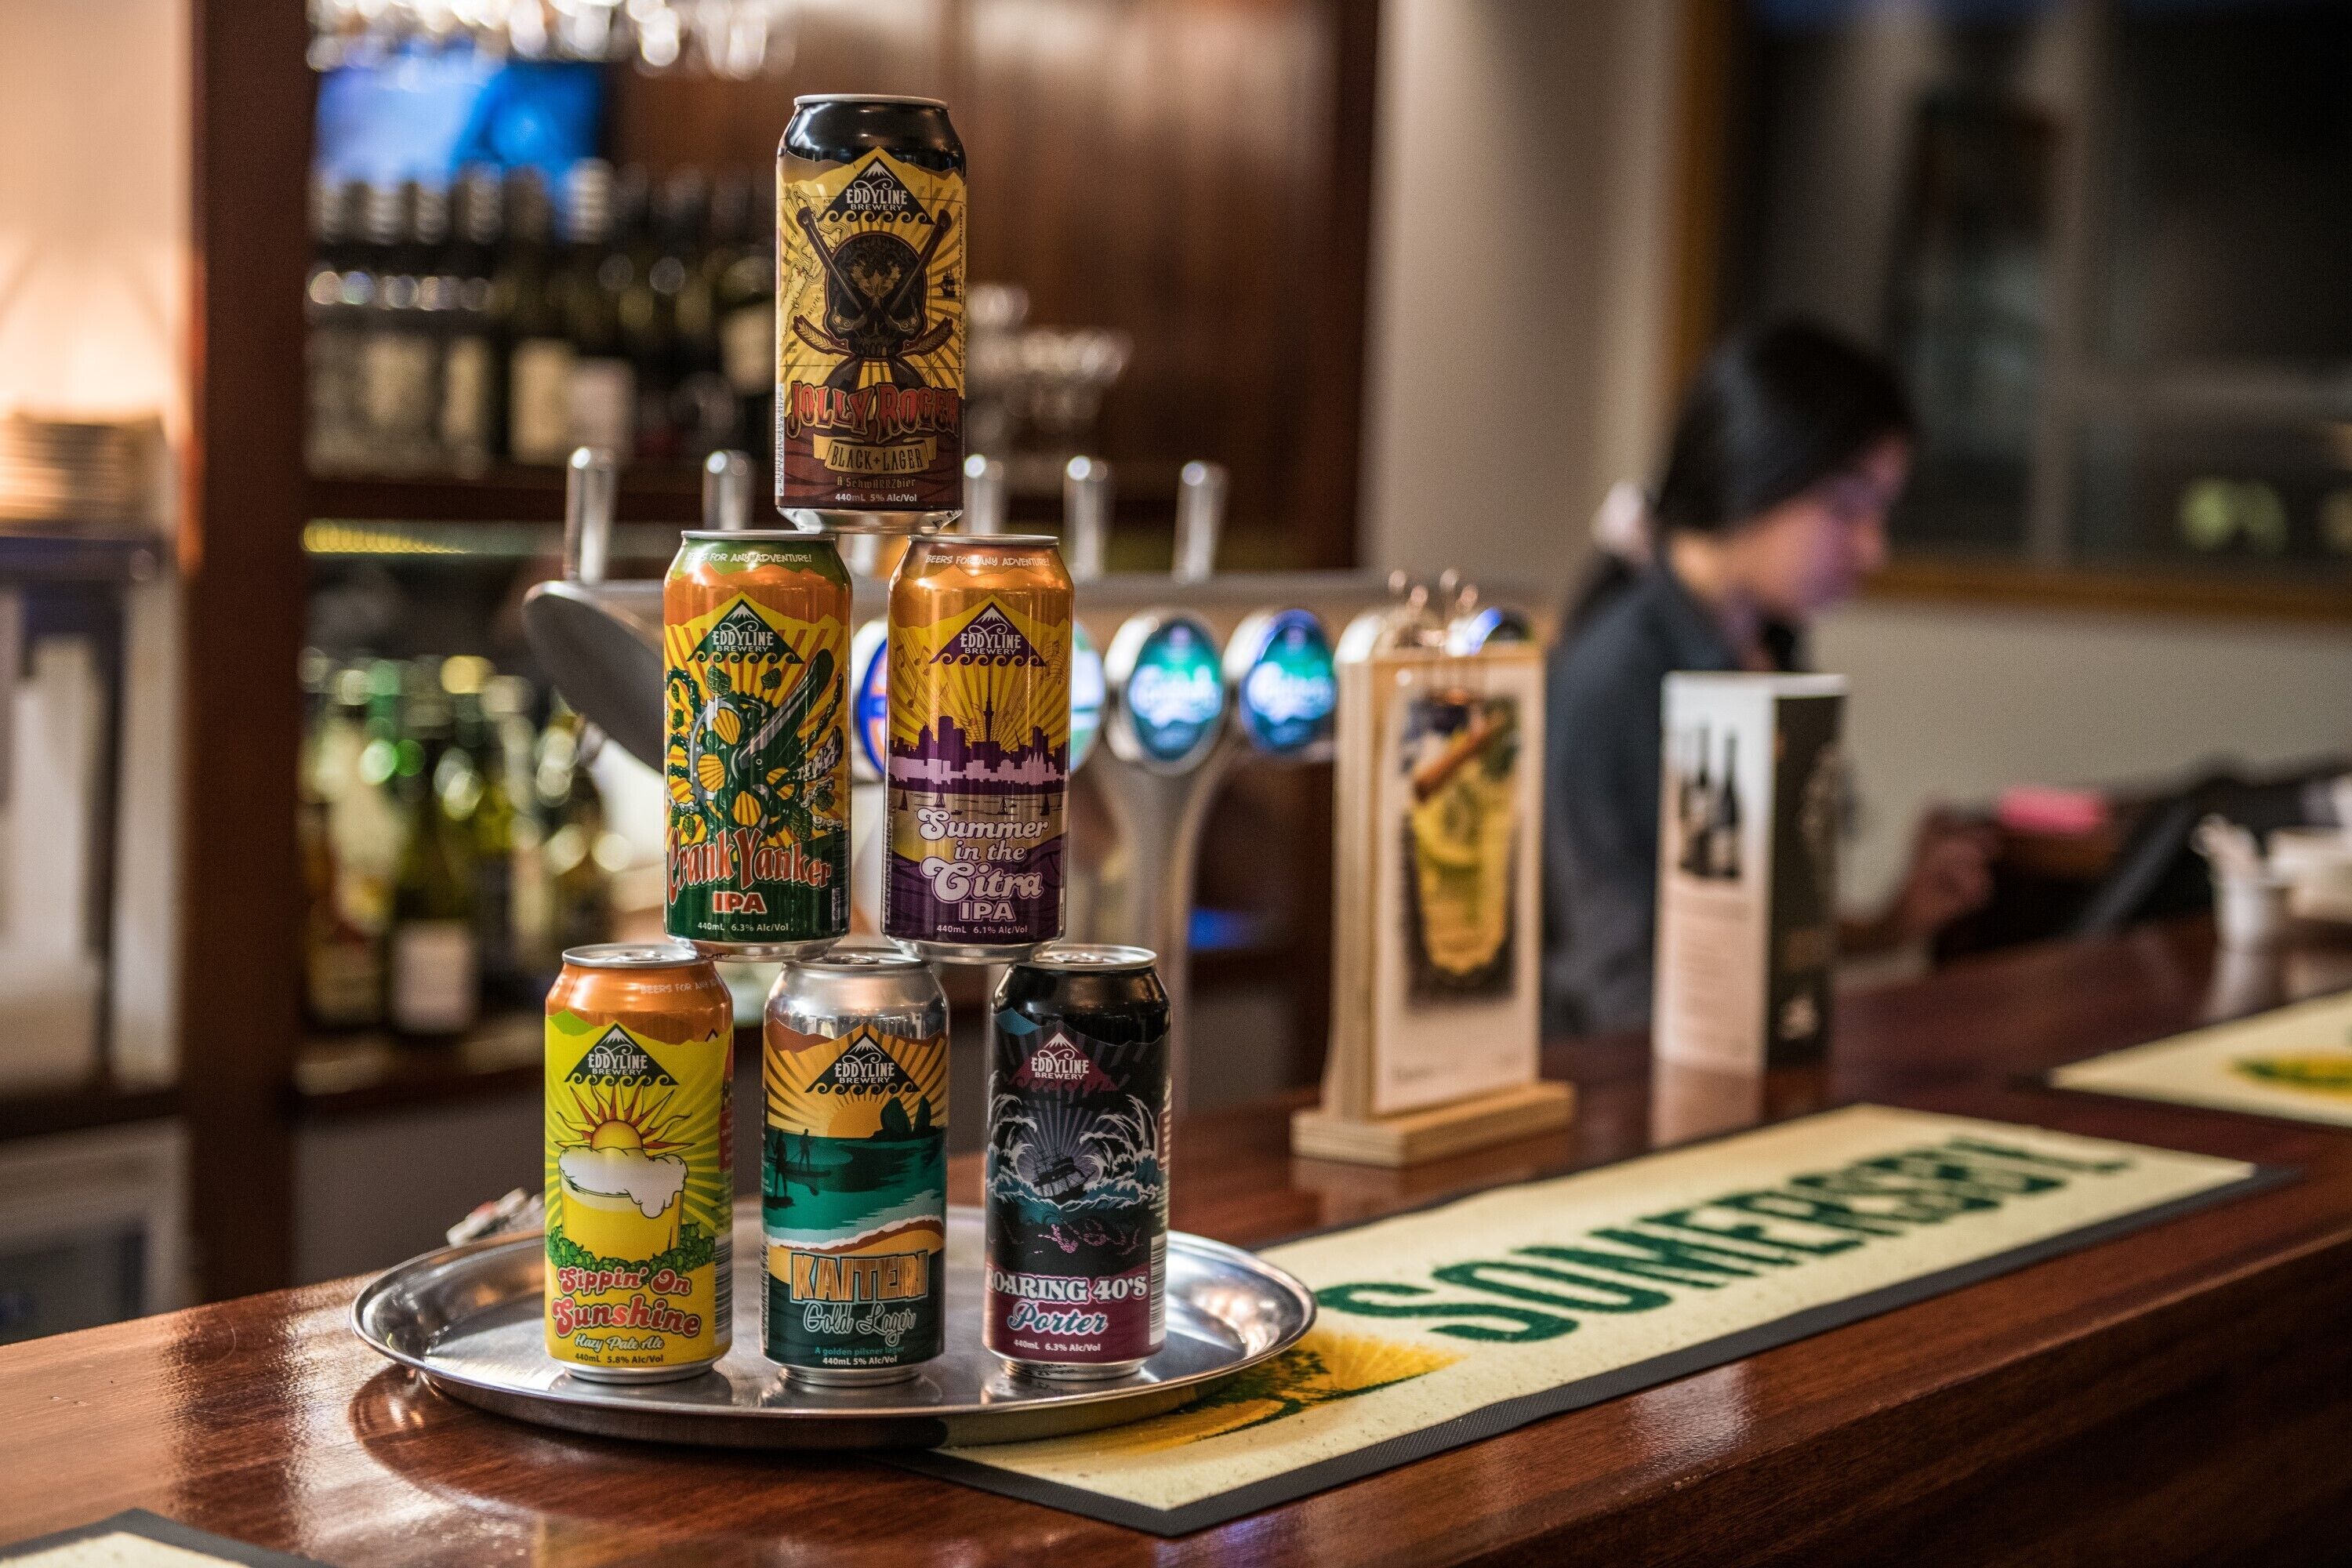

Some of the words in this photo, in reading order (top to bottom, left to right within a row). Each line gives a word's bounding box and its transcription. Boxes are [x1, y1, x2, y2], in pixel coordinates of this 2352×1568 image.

[846, 178, 907, 205] EDDYLINE
[786, 381, 874, 439] JOLLY
[831, 445, 871, 469] BLACK
[883, 446, 924, 470] LAGER
[835, 493, 866, 502] 440mL
[710, 553, 728, 561] FOR
[730, 554, 749, 562] ANY
[753, 554, 812, 563] ADVENTURE!
[925, 555, 953, 564] BEERS
[979, 557, 998, 566] ANY
[1002, 557, 1050, 567] ADVENTURE!
[712, 620, 774, 646] EDDYLINE
[960, 625, 1022, 649] EDDYLINE
[916, 808, 1049, 841] Summer
[953, 840, 982, 862] in
[985, 840, 1027, 862] the
[668, 826, 736, 906] Crank
[732, 826, 832, 891] Yanker
[920, 856, 1044, 903] Citra
[713, 891, 768, 914] IPA
[959, 900, 1016, 922] IPA
[697, 922, 725, 931] 440mL
[757, 923, 789, 931] Alc/Vol
[937, 924, 967, 933] 440mL
[973, 925, 996, 934] 6.1%
[998, 924, 1028, 934] Alc/Vol
[640, 984, 673, 994] BEERS
[676, 982, 691, 992] FOR
[588, 1044, 648, 1069] EDDYLINE
[834, 1052, 895, 1077] EDDYLINE
[1031, 1049, 1089, 1074] EDDYLINE
[1035, 1072, 1084, 1080] BREWERY
[557, 1267, 648, 1296] Sippin'
[651, 1269, 692, 1295] On
[1093, 1274, 1149, 1302] 40'S
[551, 1294, 702, 1338] Sunshine
[804, 1302, 855, 1333] Gold
[855, 1302, 916, 1347] Lager
[1007, 1299, 1108, 1335] Porter
[575, 1334, 604, 1353] Hazy
[606, 1336, 639, 1350] Pale
[641, 1336, 665, 1349] Ale
[822, 1348, 852, 1356] golden
[1045, 1343, 1067, 1352] 6.3%
[1069, 1343, 1101, 1352] Alc/Vol
[575, 1353, 601, 1363] 440mL
[632, 1355, 664, 1363] Alc/Vol
[869, 1355, 898, 1364] Alc/Vol
